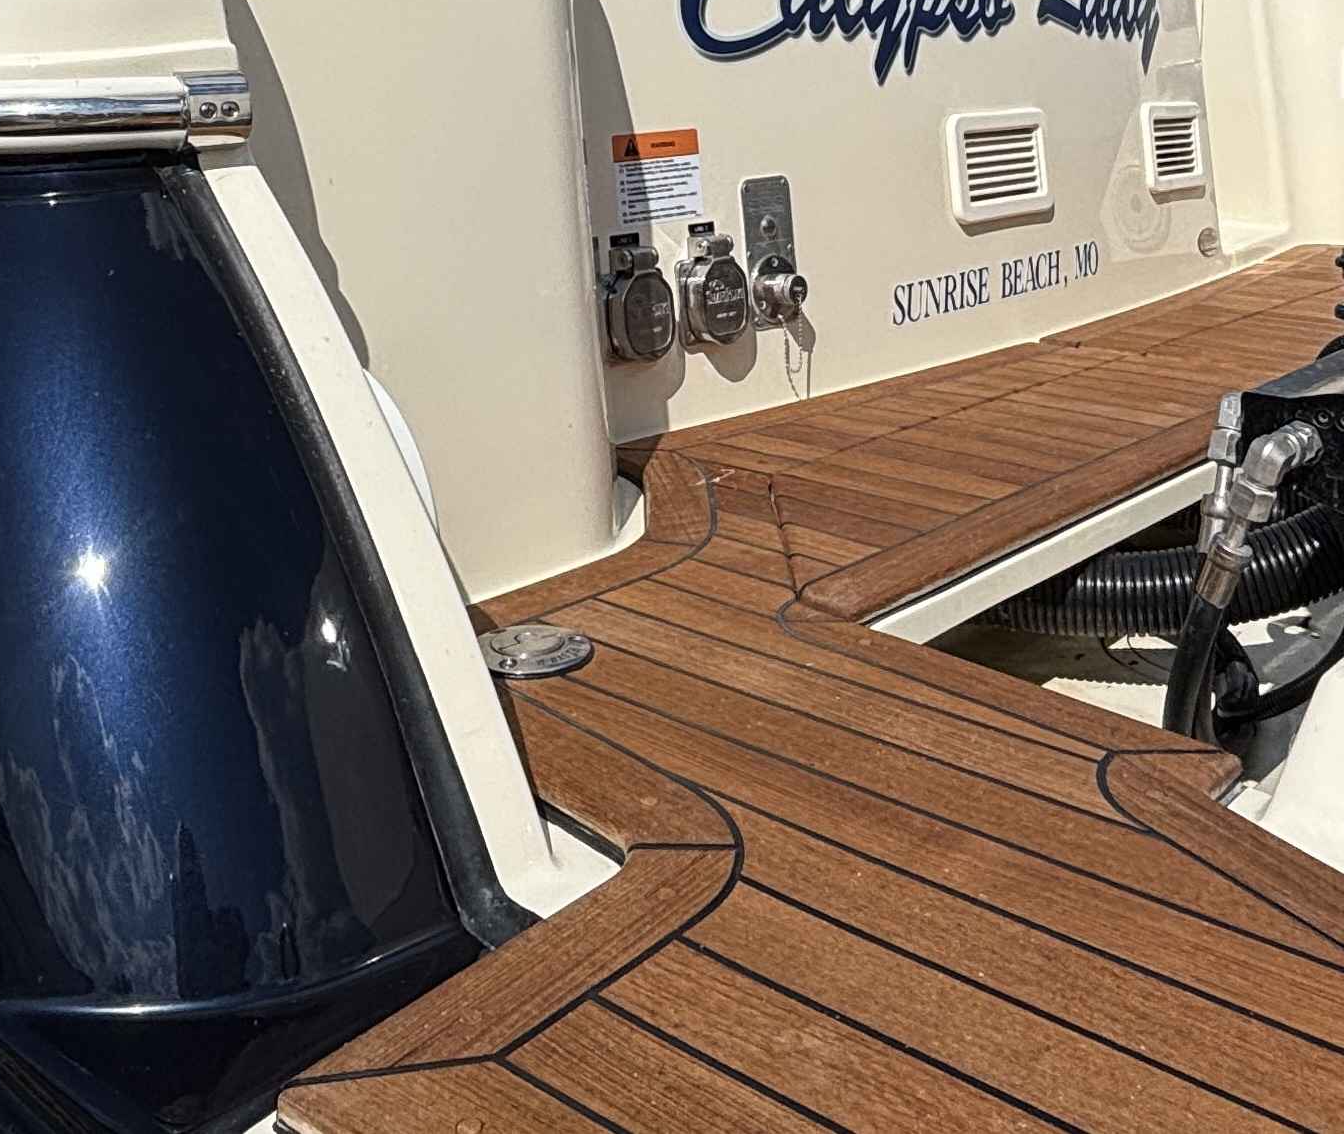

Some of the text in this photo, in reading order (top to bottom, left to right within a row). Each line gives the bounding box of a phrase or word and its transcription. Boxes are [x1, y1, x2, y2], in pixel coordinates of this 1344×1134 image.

[892, 241, 1099, 326] SUNRISE BEACH, MO
